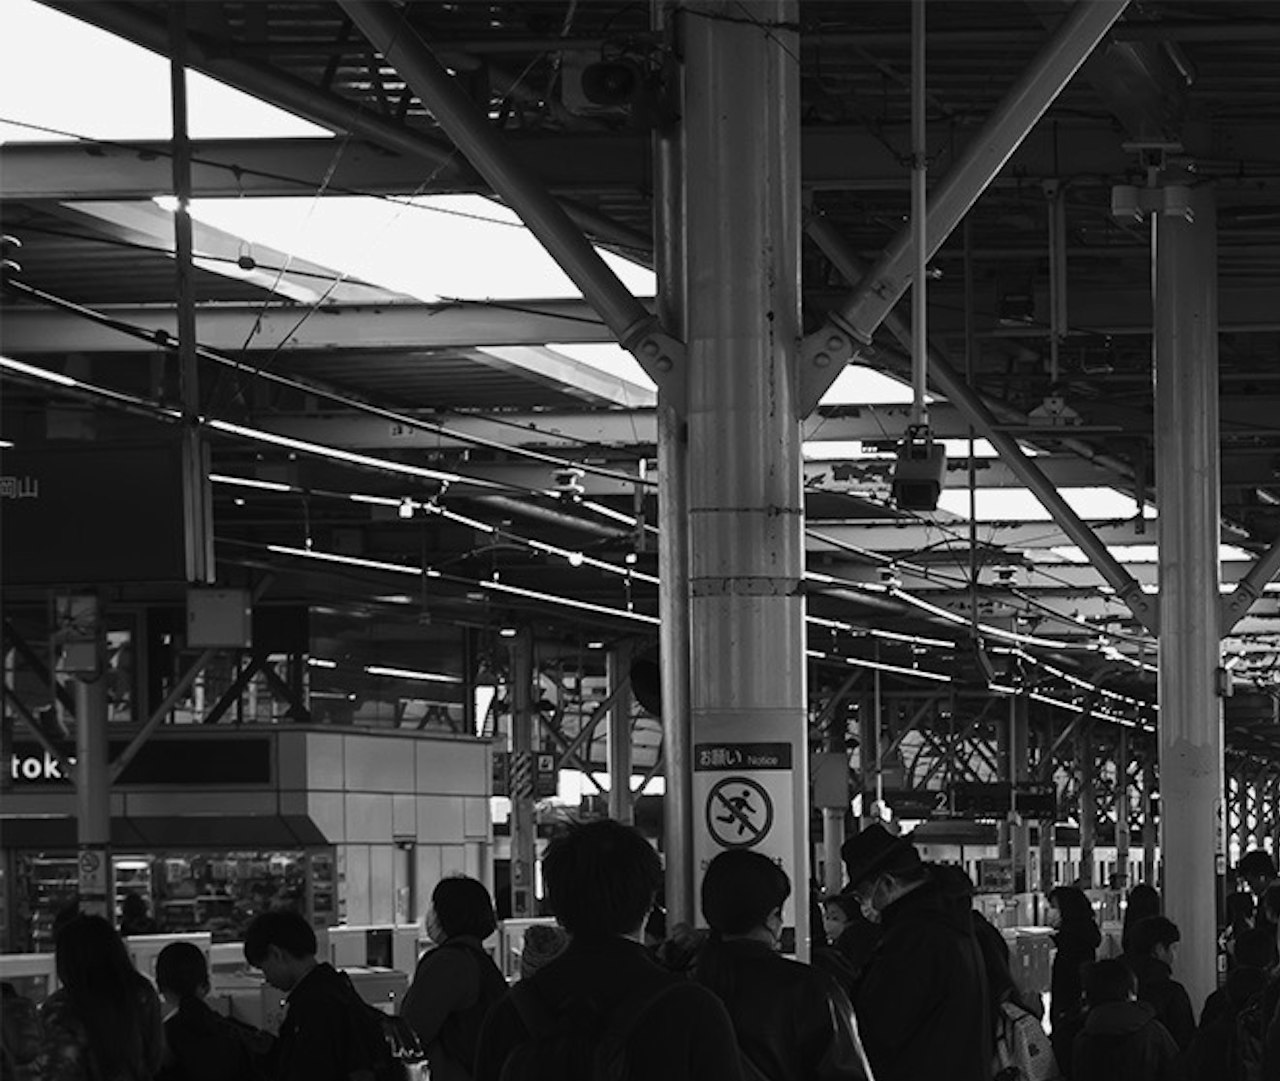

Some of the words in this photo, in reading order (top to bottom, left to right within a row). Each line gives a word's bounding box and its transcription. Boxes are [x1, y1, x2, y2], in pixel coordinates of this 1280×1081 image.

[700, 748, 742, 766] お願い
[747, 755, 779, 766] Notice
[935, 792, 948, 809] 2
